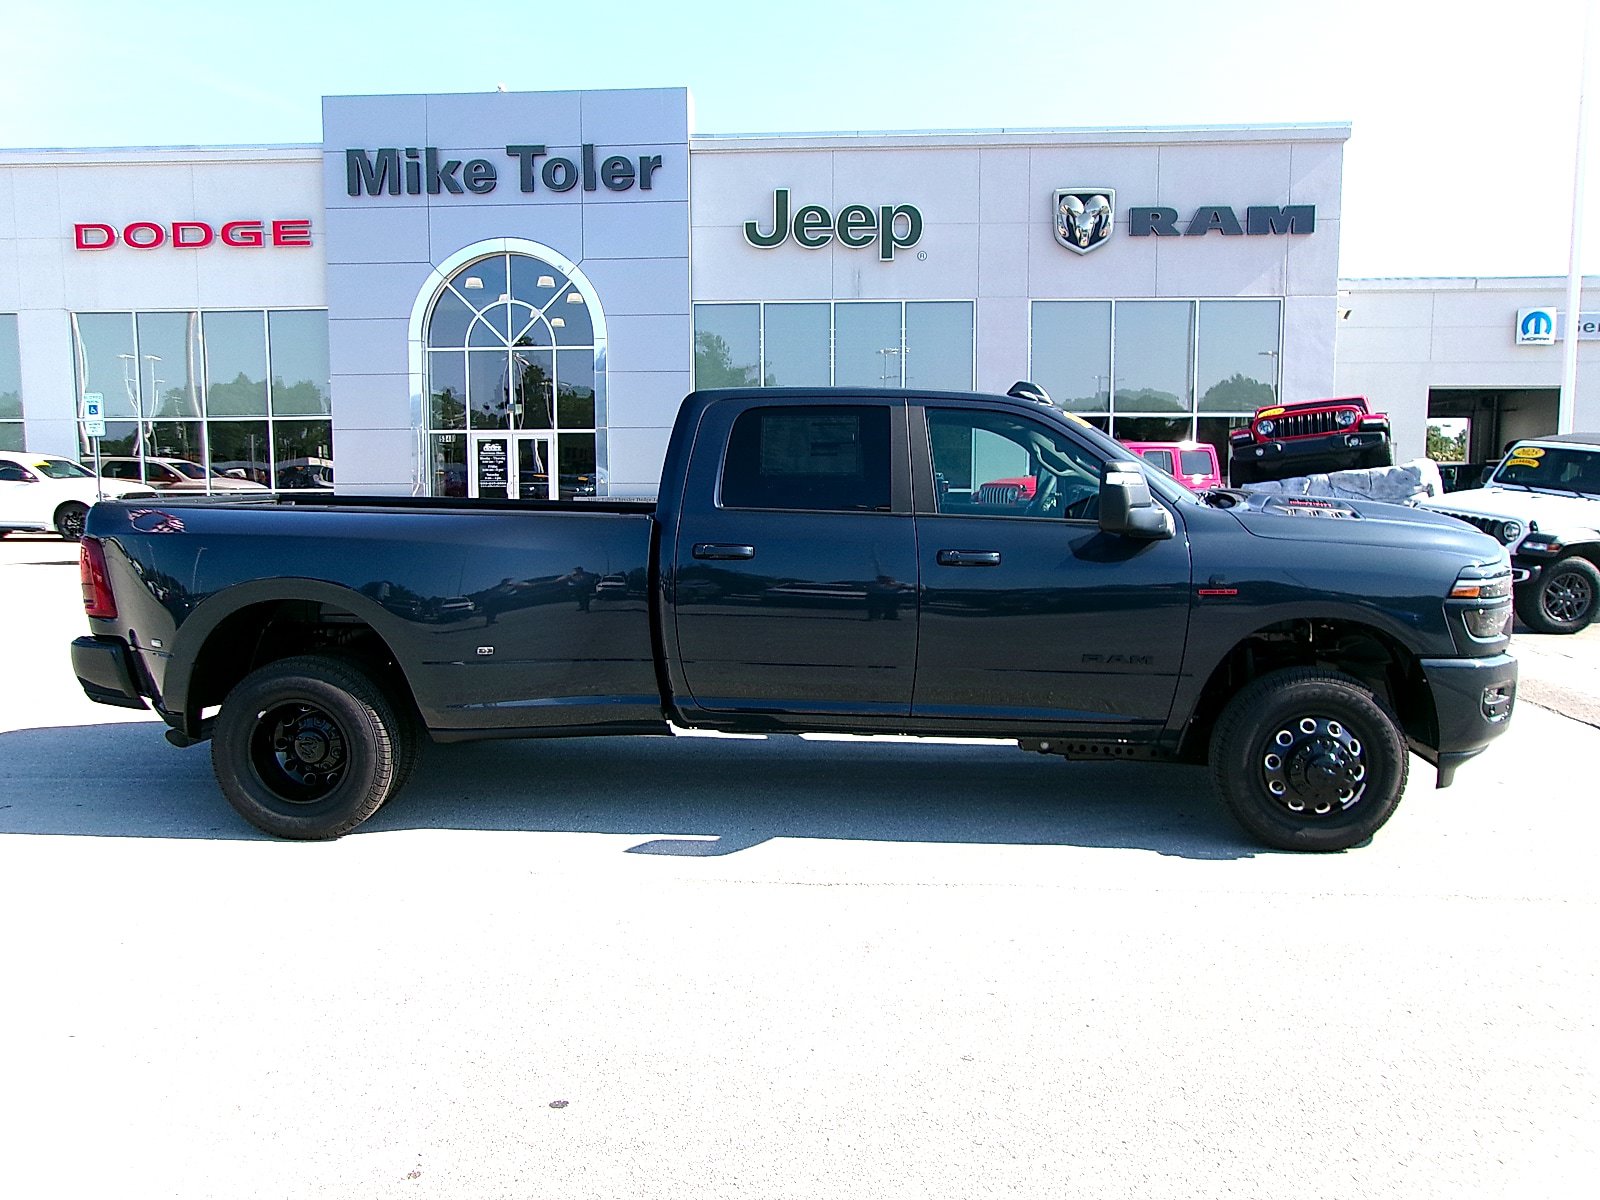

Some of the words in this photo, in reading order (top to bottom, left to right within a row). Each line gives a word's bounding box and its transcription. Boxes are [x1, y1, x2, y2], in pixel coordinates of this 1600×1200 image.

[346, 147, 498, 196] Mike
[506, 143, 662, 193] Toler
[73, 219, 312, 250] DODGE
[743, 187, 924, 262] Jeep
[1128, 204, 1316, 237] RAM
